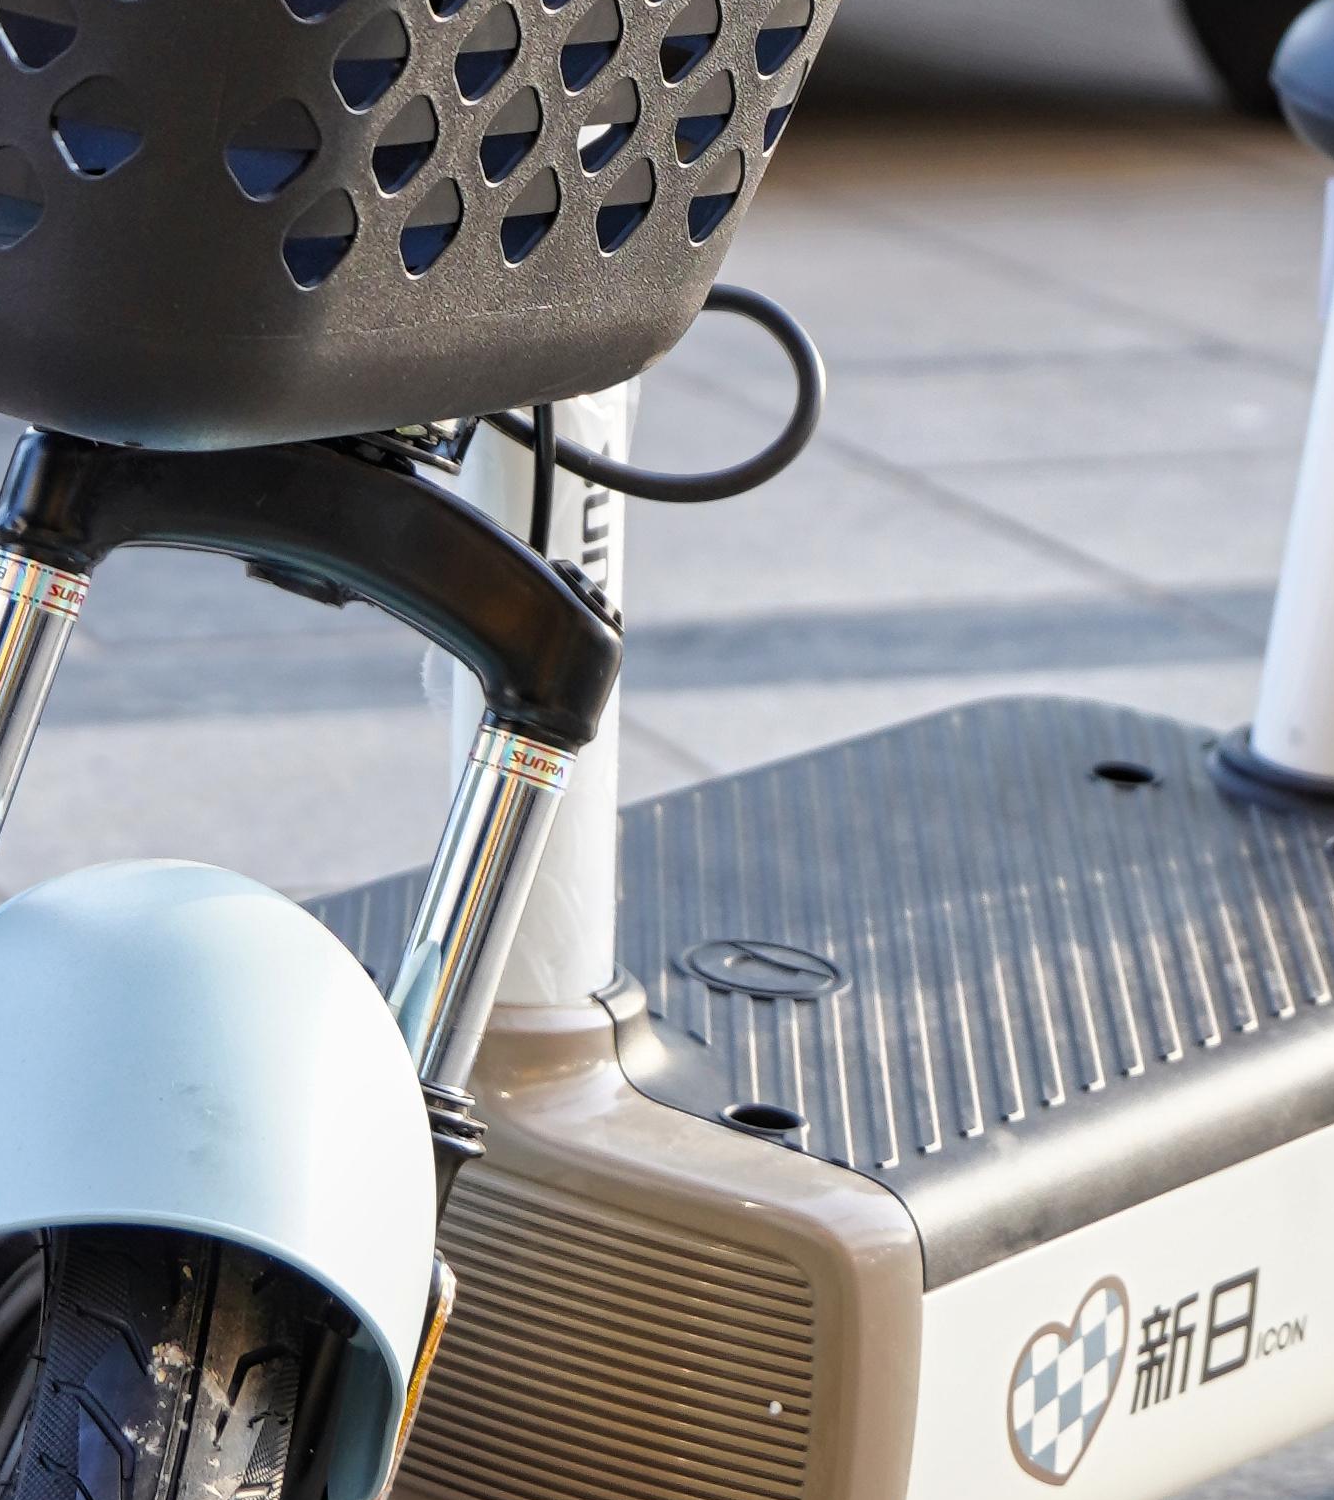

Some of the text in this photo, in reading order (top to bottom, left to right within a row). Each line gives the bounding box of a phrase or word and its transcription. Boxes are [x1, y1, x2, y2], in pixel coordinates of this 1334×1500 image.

[509, 750, 564, 778] SUNRA
[1130, 1267, 1308, 1415] 新日 ICON
